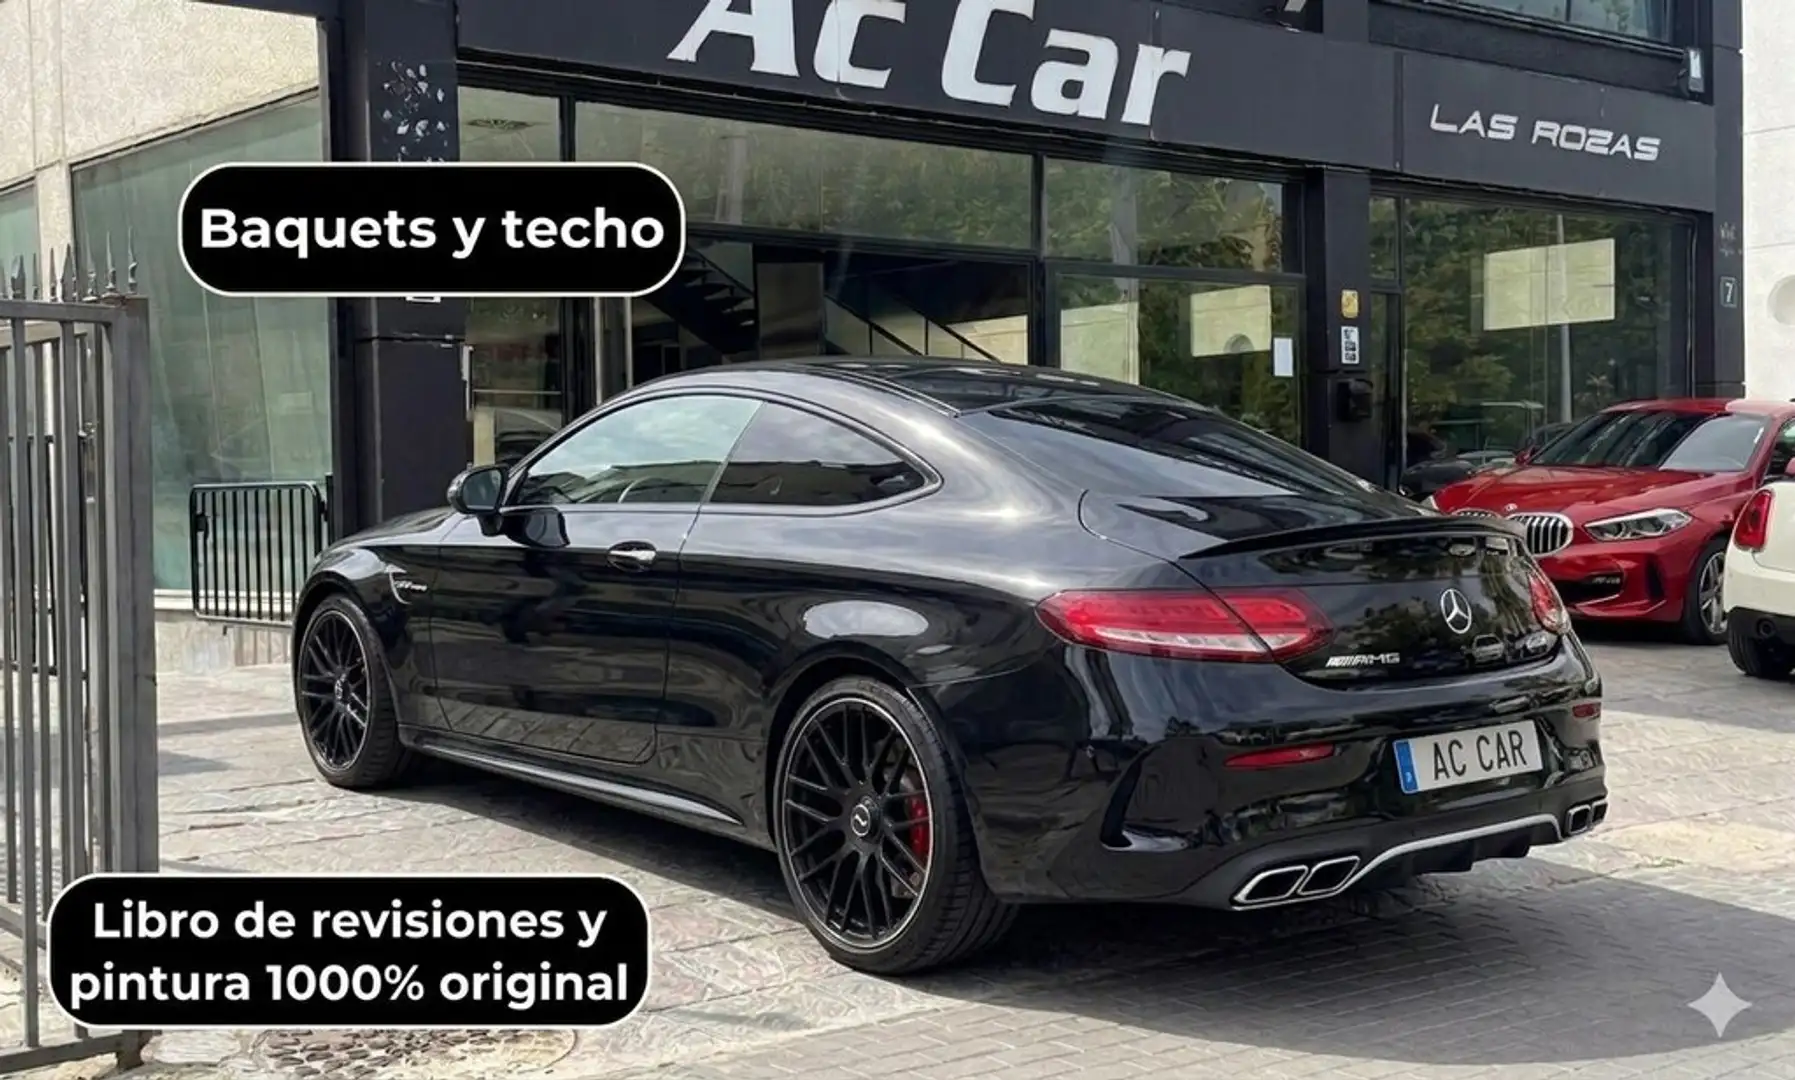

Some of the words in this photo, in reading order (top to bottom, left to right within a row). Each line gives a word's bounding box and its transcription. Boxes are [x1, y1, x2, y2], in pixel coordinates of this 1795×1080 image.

[667, 0, 906, 89] Ac
[941, 0, 1191, 126] Car
[1430, 103, 1519, 141] LAS
[1531, 120, 1662, 162] ROZAS
[1433, 739, 1466, 781] AC
[1476, 729, 1527, 772] CAR
